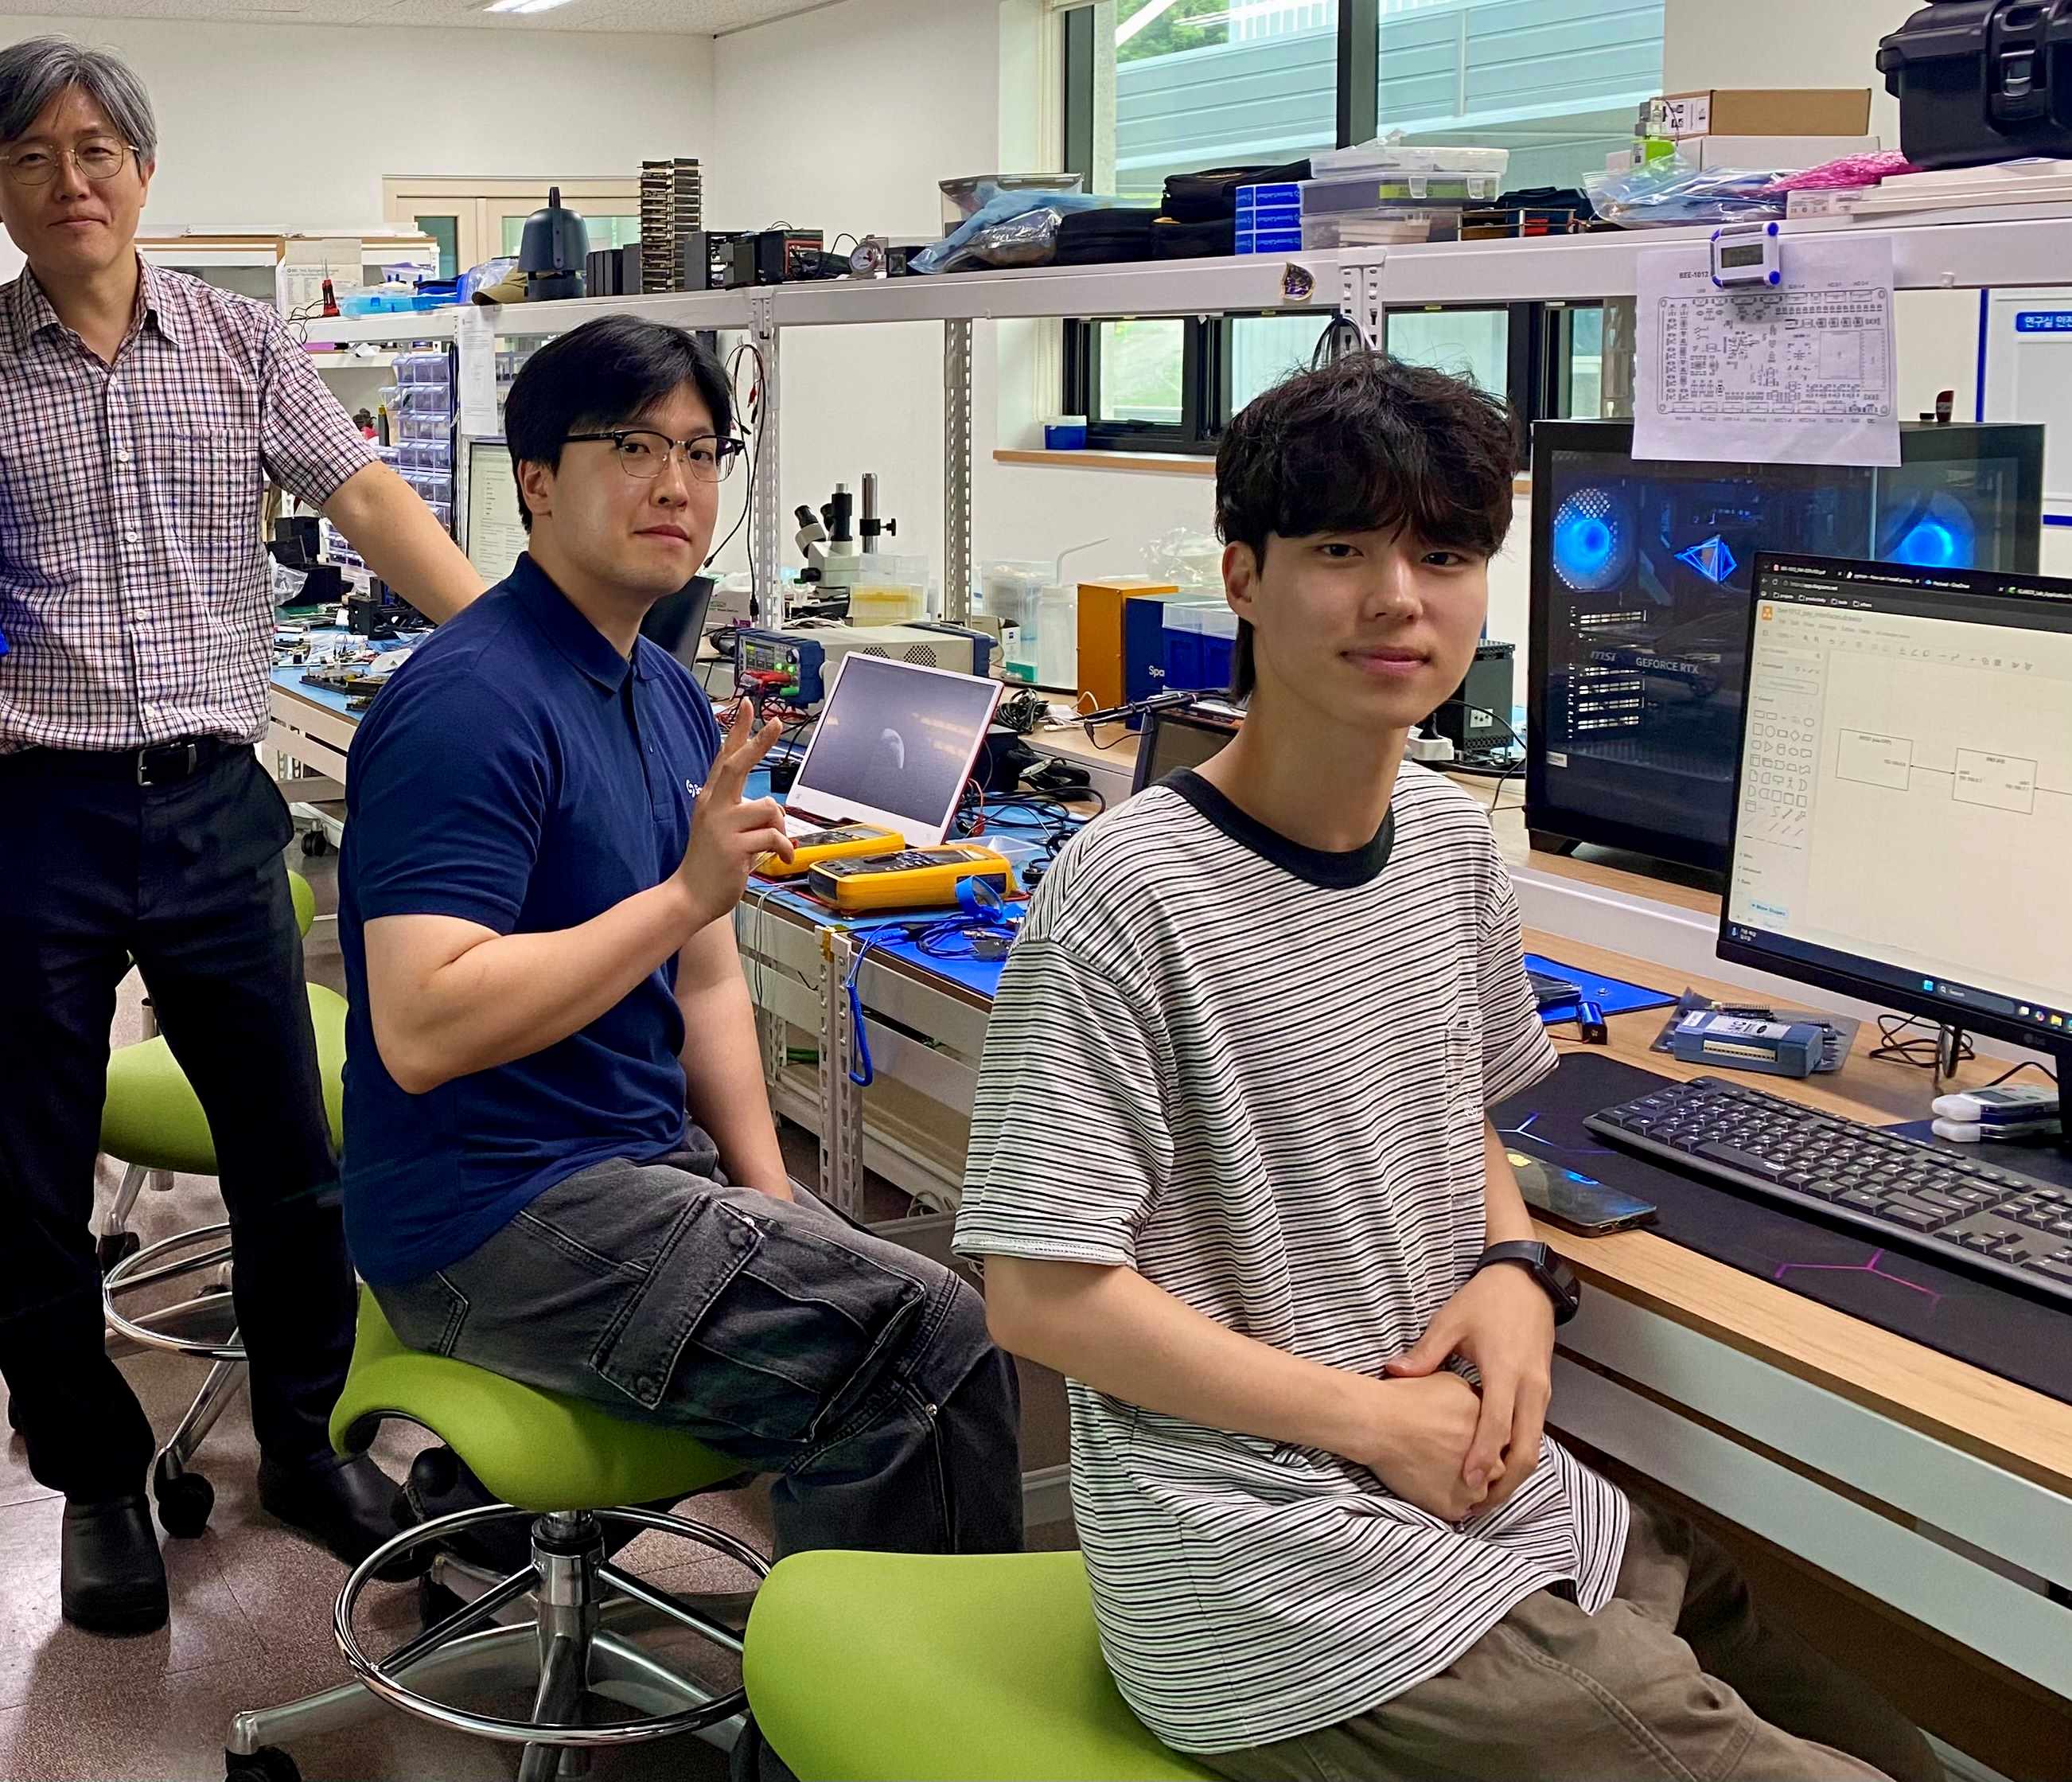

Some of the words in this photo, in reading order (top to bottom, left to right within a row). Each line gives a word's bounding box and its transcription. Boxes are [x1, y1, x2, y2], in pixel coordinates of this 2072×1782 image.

[1591, 650, 1617, 662] msi
[1148, 665, 1166, 678] Spa
[1635, 657, 1678, 672] GEFORCE
[1680, 662, 1699, 674] RTX
